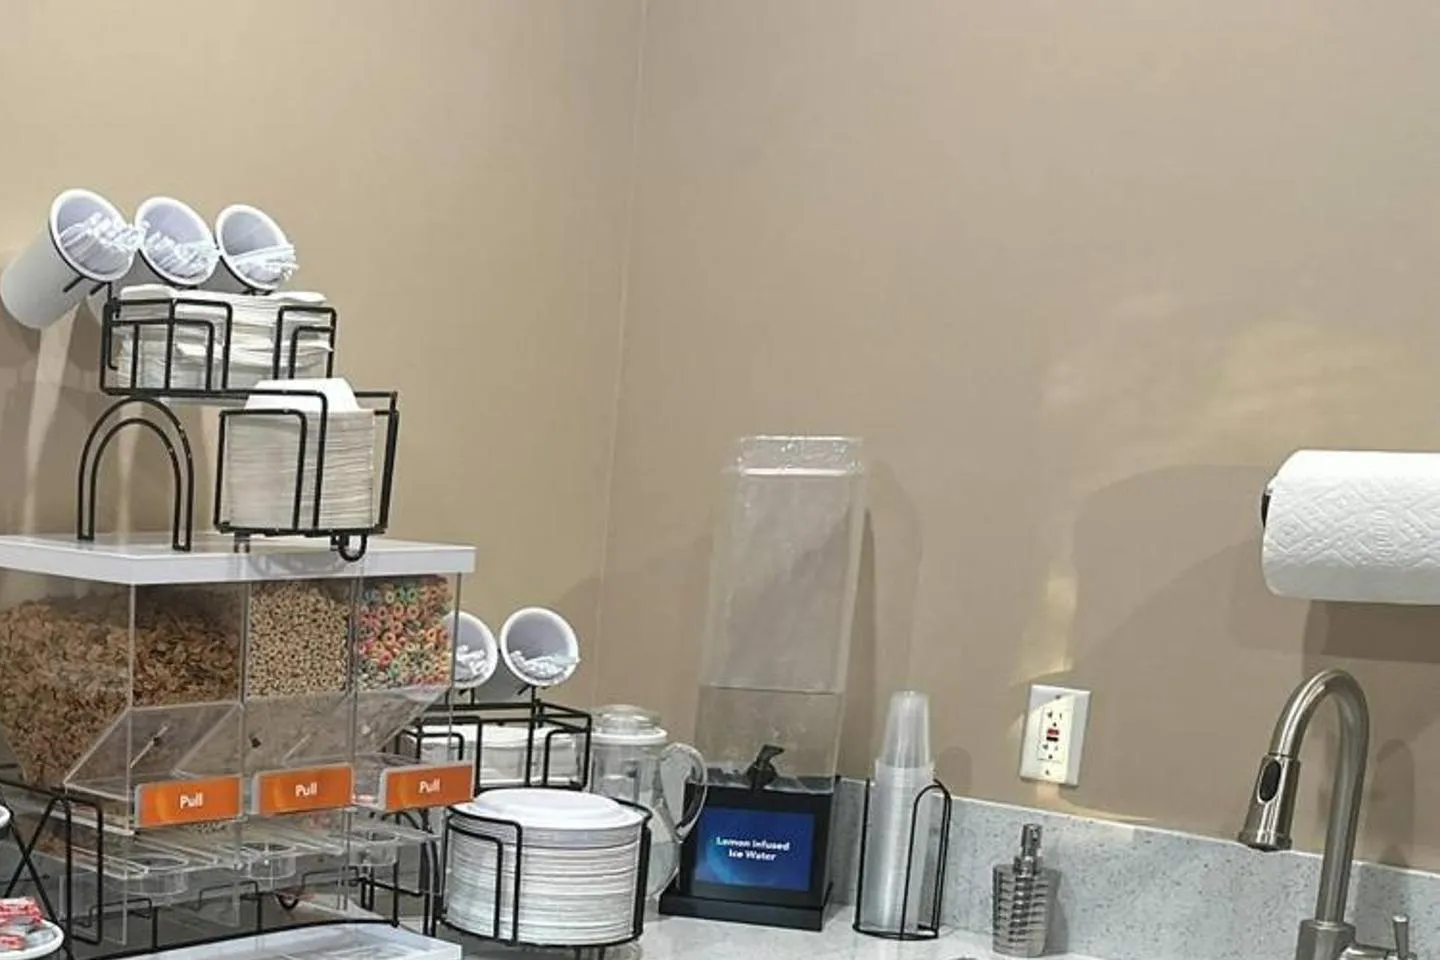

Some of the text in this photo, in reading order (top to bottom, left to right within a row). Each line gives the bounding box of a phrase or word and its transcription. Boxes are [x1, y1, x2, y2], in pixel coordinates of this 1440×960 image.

[295, 782, 318, 799] Pull
[419, 778, 441, 794] Pull
[180, 794, 203, 809] Pull
[716, 836, 791, 851] Lemon Infused
[728, 848, 777, 861] Ice Water
